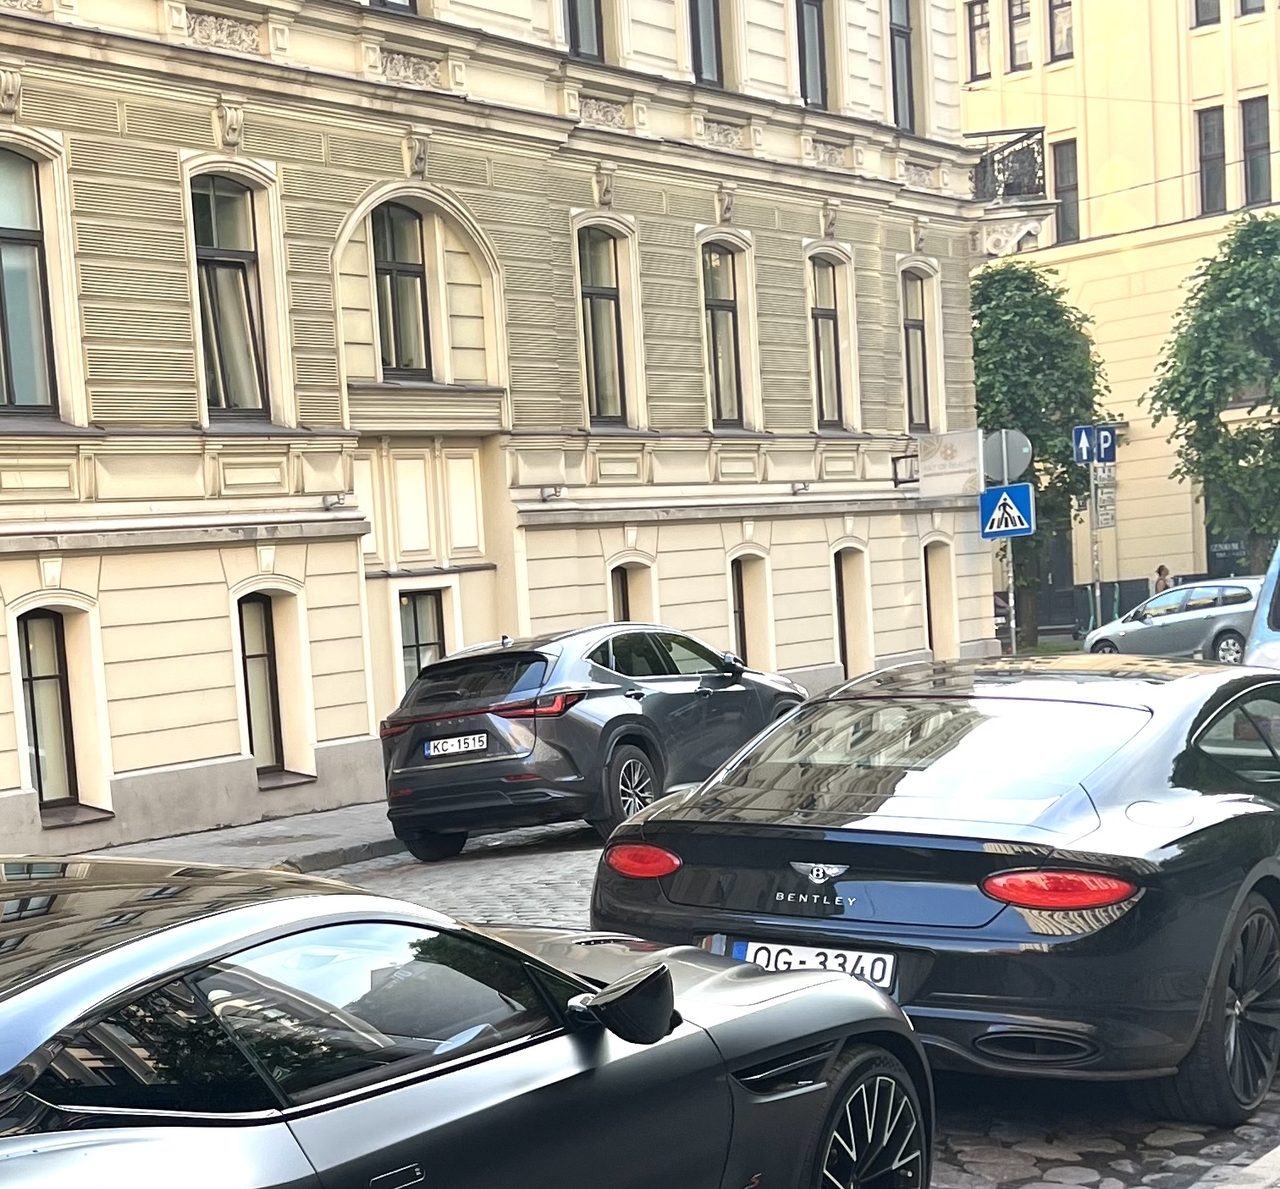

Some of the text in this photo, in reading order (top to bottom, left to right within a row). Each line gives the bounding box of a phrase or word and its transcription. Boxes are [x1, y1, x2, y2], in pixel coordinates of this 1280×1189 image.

[1100, 430, 1112, 458] P
[433, 735, 485, 753] KC-1515
[775, 892, 857, 906] BENTLEY
